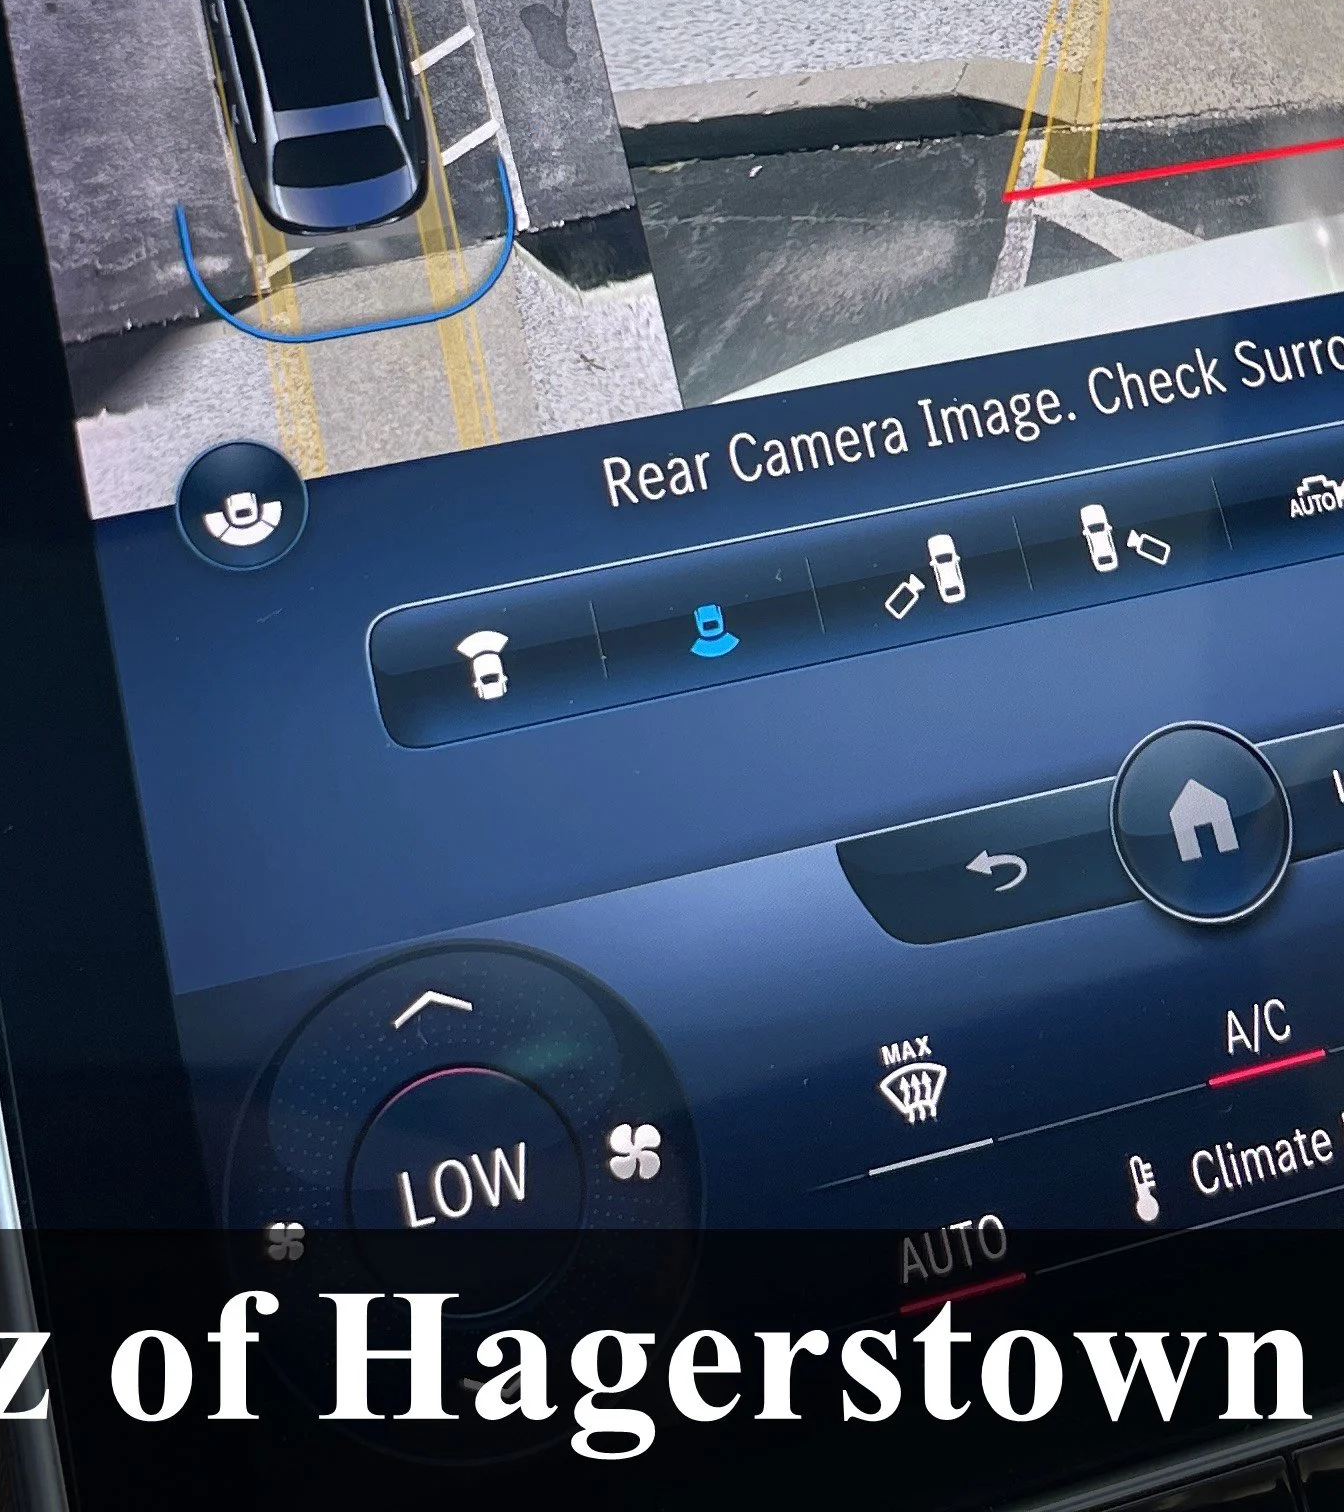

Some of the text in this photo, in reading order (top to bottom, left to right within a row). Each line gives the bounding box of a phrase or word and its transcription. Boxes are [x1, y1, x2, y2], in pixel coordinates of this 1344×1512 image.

[602, 446, 714, 507] Rear
[728, 418, 910, 486] Camera
[919, 389, 1077, 449] Image.
[1088, 355, 1226, 417] Check
[1289, 492, 1336, 518] AUTO
[880, 1035, 932, 1065] MAX
[1225, 997, 1292, 1056] A/C
[396, 1142, 529, 1229] LOW
[1190, 1128, 1335, 1198] Climate
[899, 1214, 1008, 1284] AUTO
